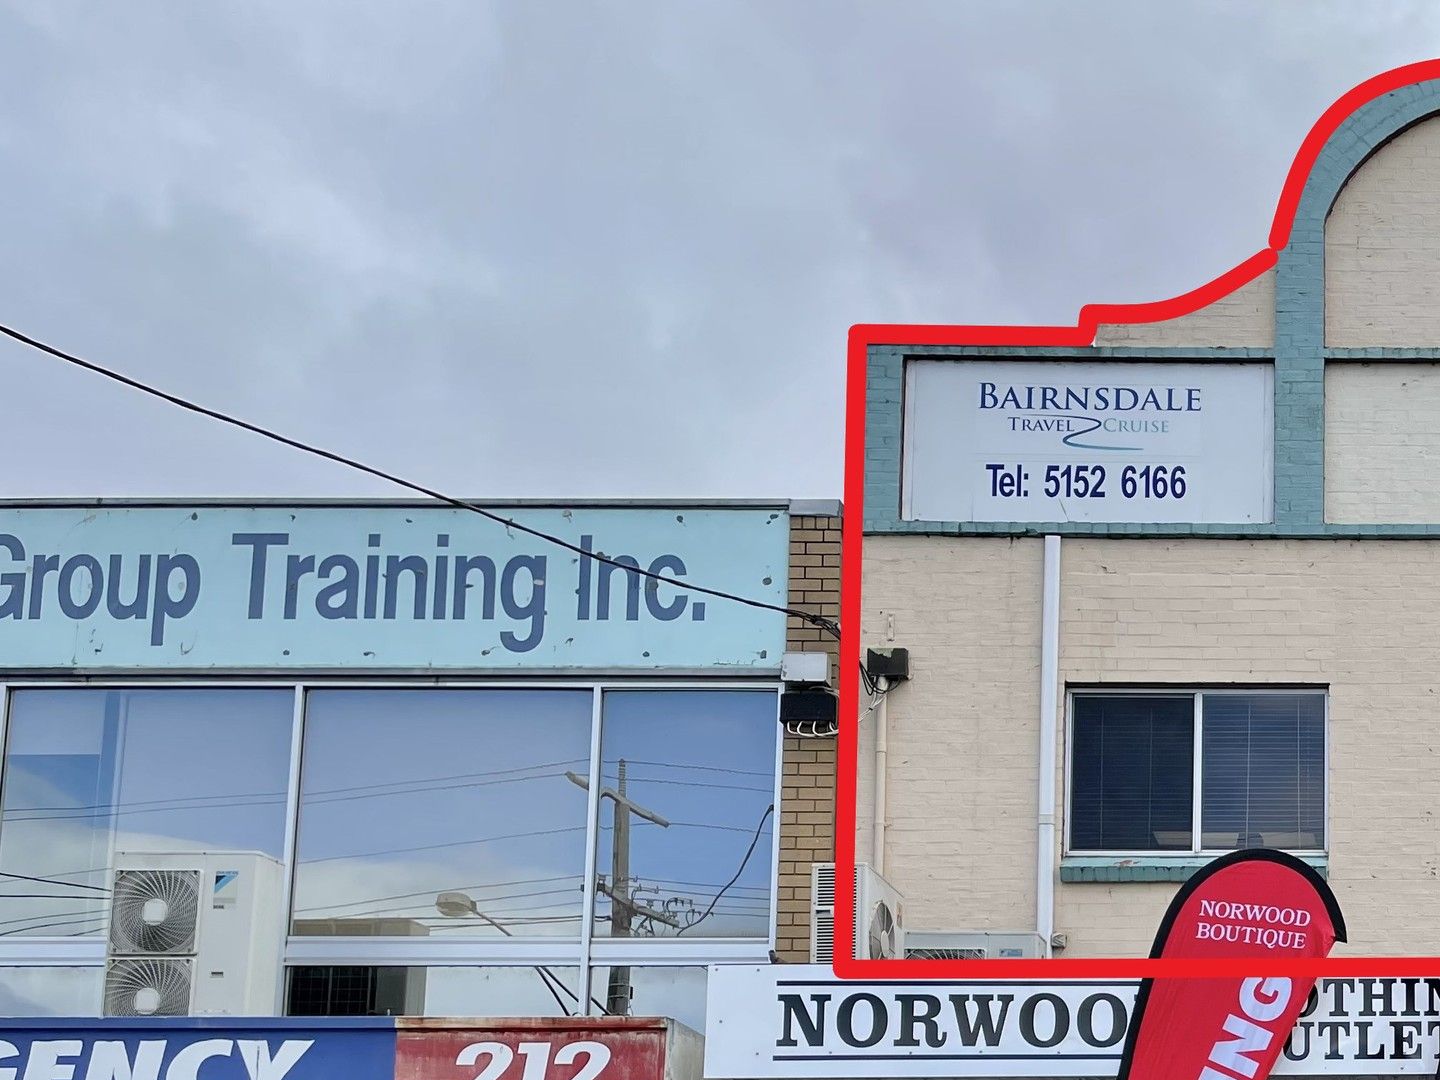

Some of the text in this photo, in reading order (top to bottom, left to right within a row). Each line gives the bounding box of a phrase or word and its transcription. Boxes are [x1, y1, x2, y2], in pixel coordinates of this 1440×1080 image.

[979, 382, 1201, 412] BAIRNSDALE
[1008, 417, 1169, 433] TRAVEL CRUISE
[986, 464, 1186, 498] Tel: 5152 6166
[232, 533, 548, 653] Training
[578, 534, 706, 622] Inc.
[1200, 899, 1311, 928] NORWOOD
[1195, 921, 1306, 950] BOUTIQUE
[775, 990, 1139, 1050] NORWOO
